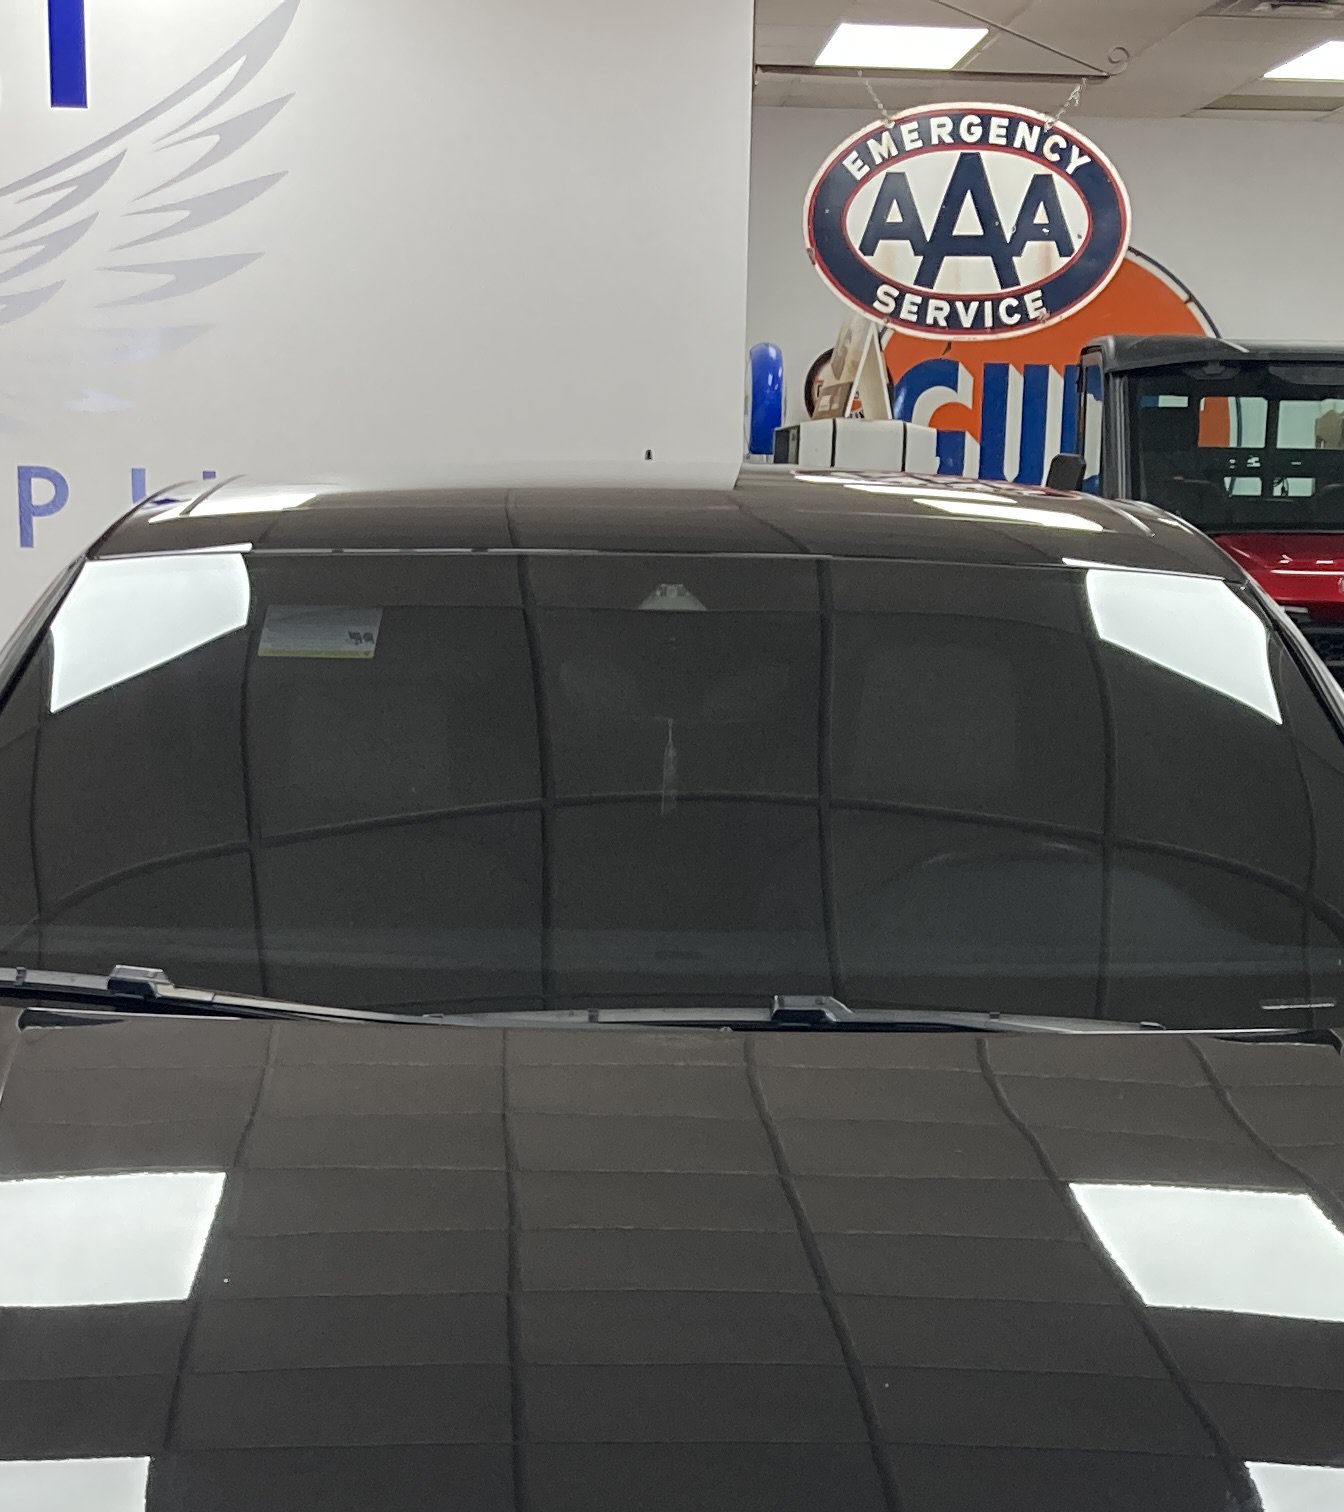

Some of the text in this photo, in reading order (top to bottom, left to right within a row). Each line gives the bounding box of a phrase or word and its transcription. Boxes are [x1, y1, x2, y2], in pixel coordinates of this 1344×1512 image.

[841, 113, 1092, 182] EMERGENCY
[858, 151, 1076, 290] AAA
[872, 284, 1049, 329] SERVICE
